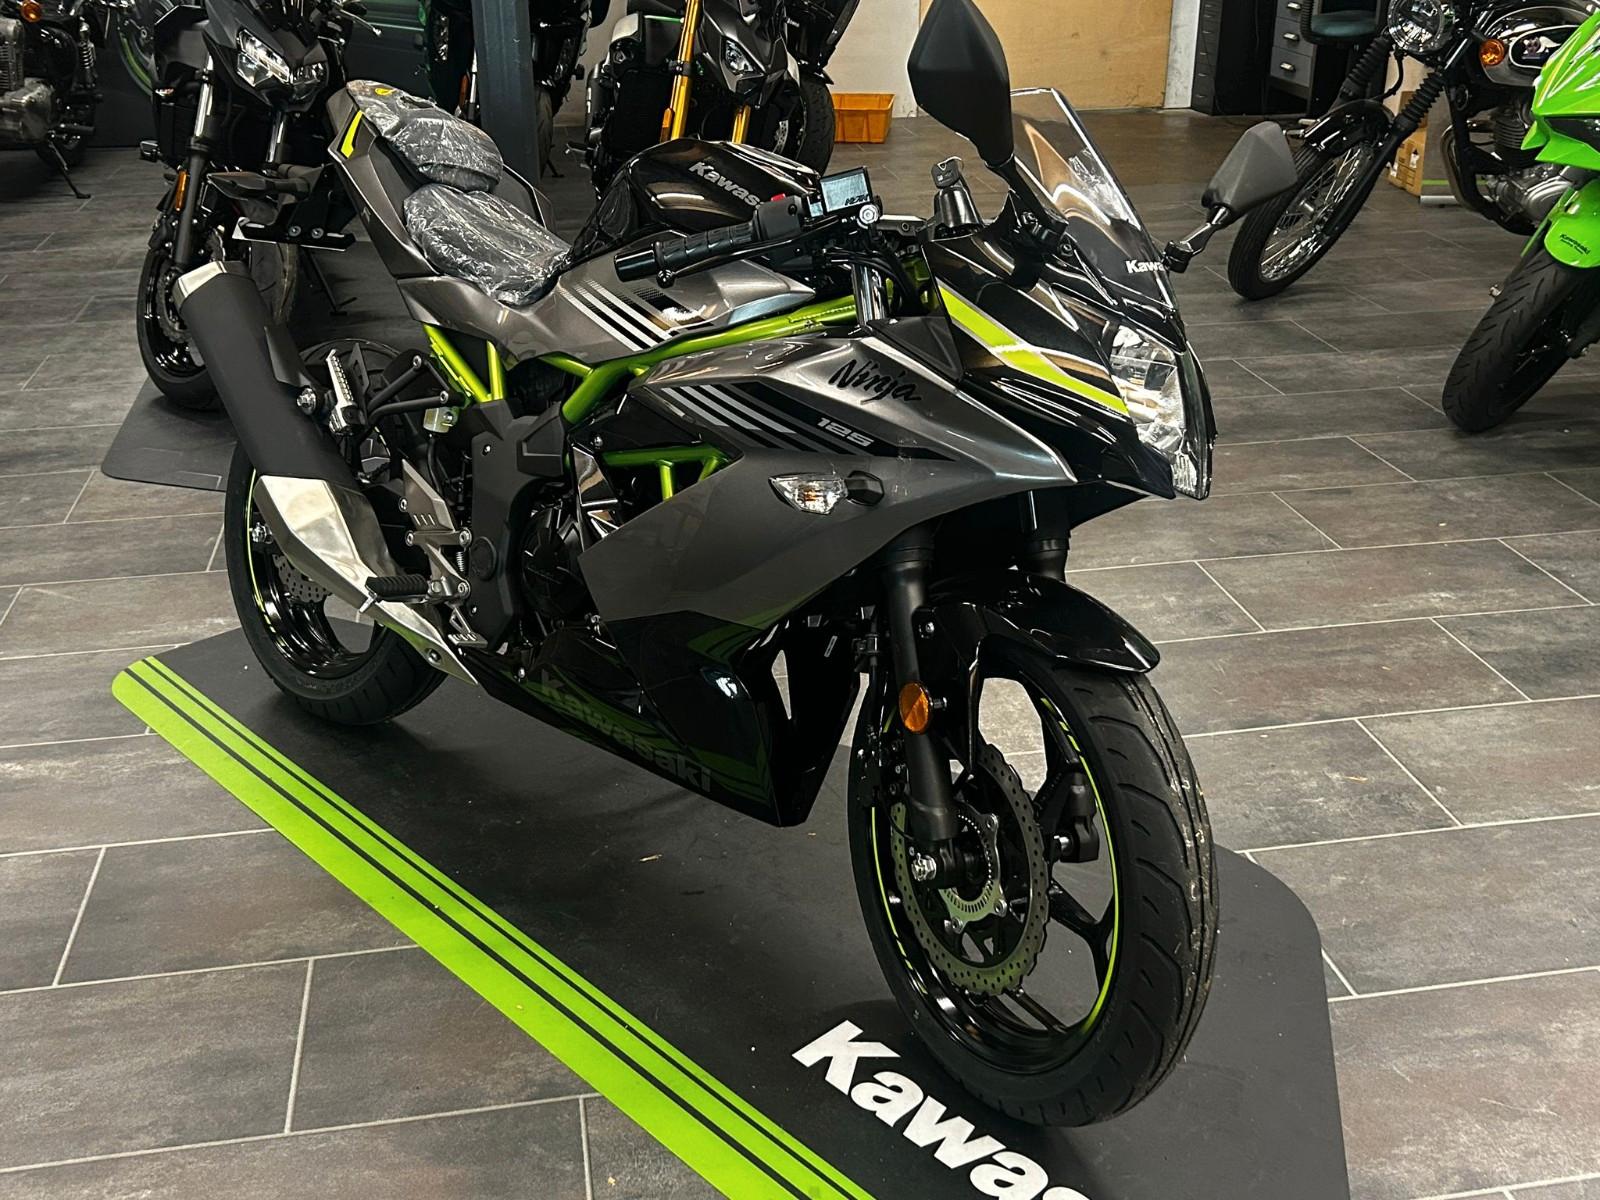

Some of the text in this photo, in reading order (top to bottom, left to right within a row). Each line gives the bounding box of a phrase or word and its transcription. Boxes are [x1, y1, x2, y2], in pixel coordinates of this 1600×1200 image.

[688, 162, 767, 208] Kawas
[828, 359, 922, 405] Ninja
[817, 417, 875, 447] 125
[542, 668, 711, 793] Kawasaki
